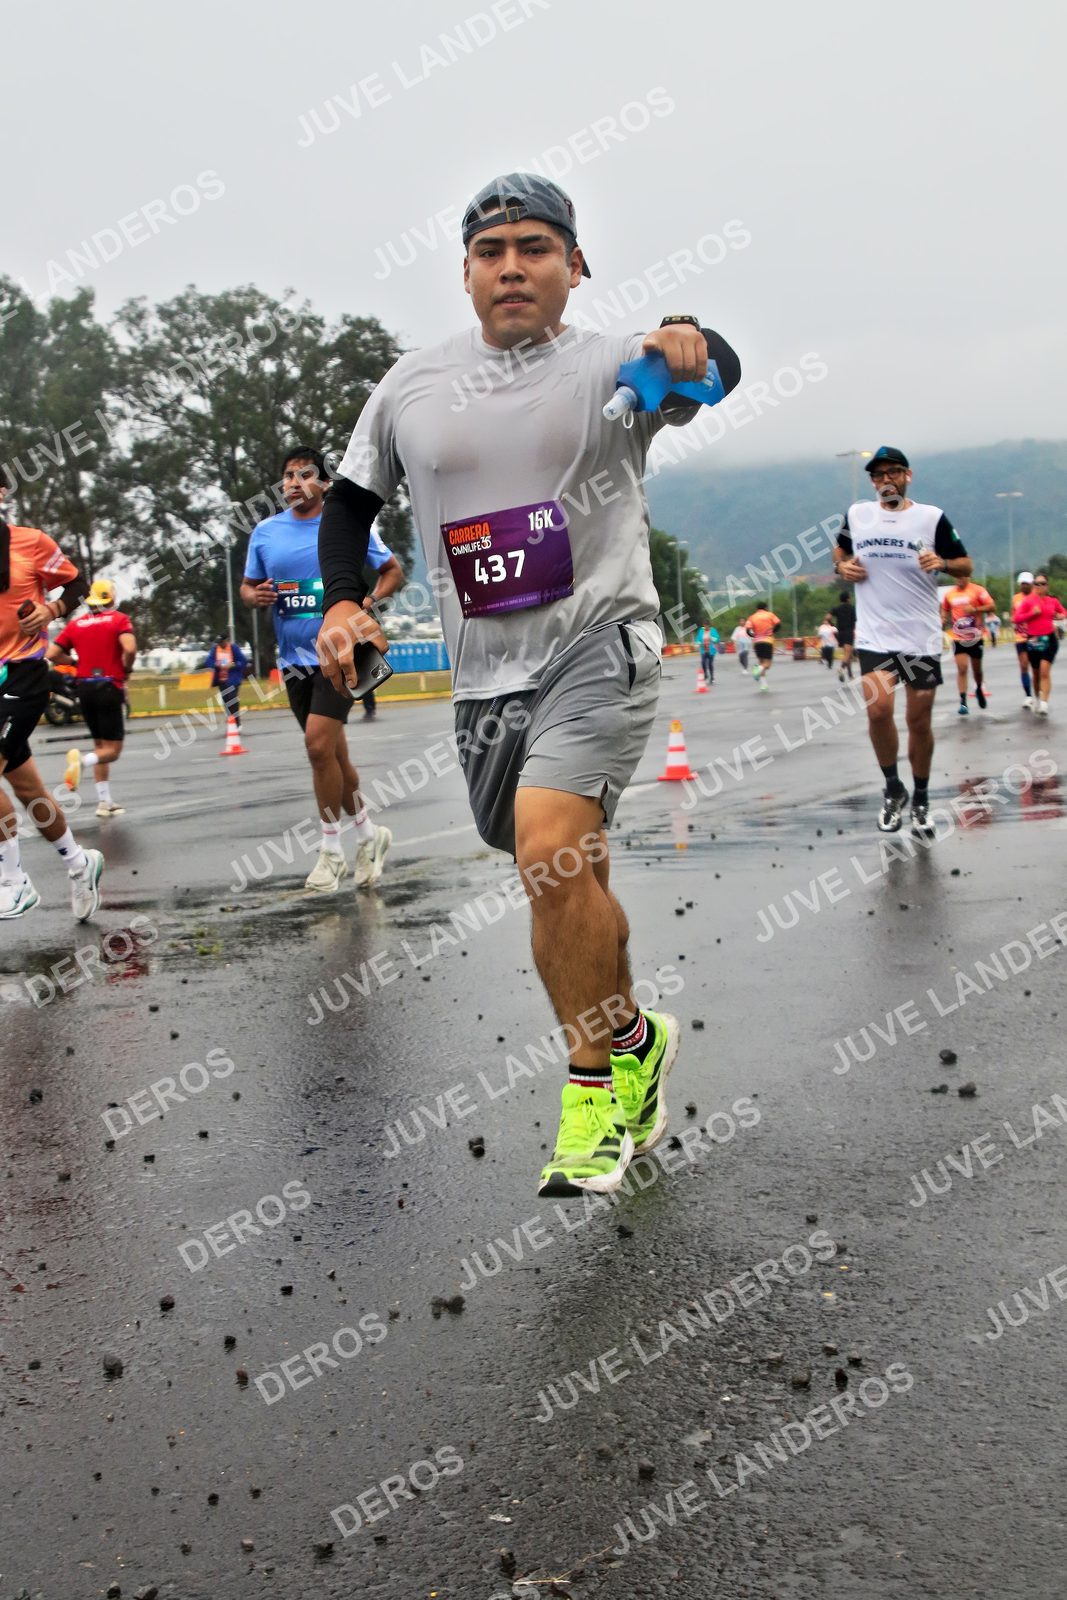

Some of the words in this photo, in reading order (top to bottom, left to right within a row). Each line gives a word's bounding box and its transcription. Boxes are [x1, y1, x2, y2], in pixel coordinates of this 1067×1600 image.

[449, 522, 491, 545] CARRERA
[452, 541, 482, 556] OMNILIFE
[856, 538, 905, 550] RUNNERS
[474, 549, 526, 585] 437
[284, 595, 316, 608] 1678
